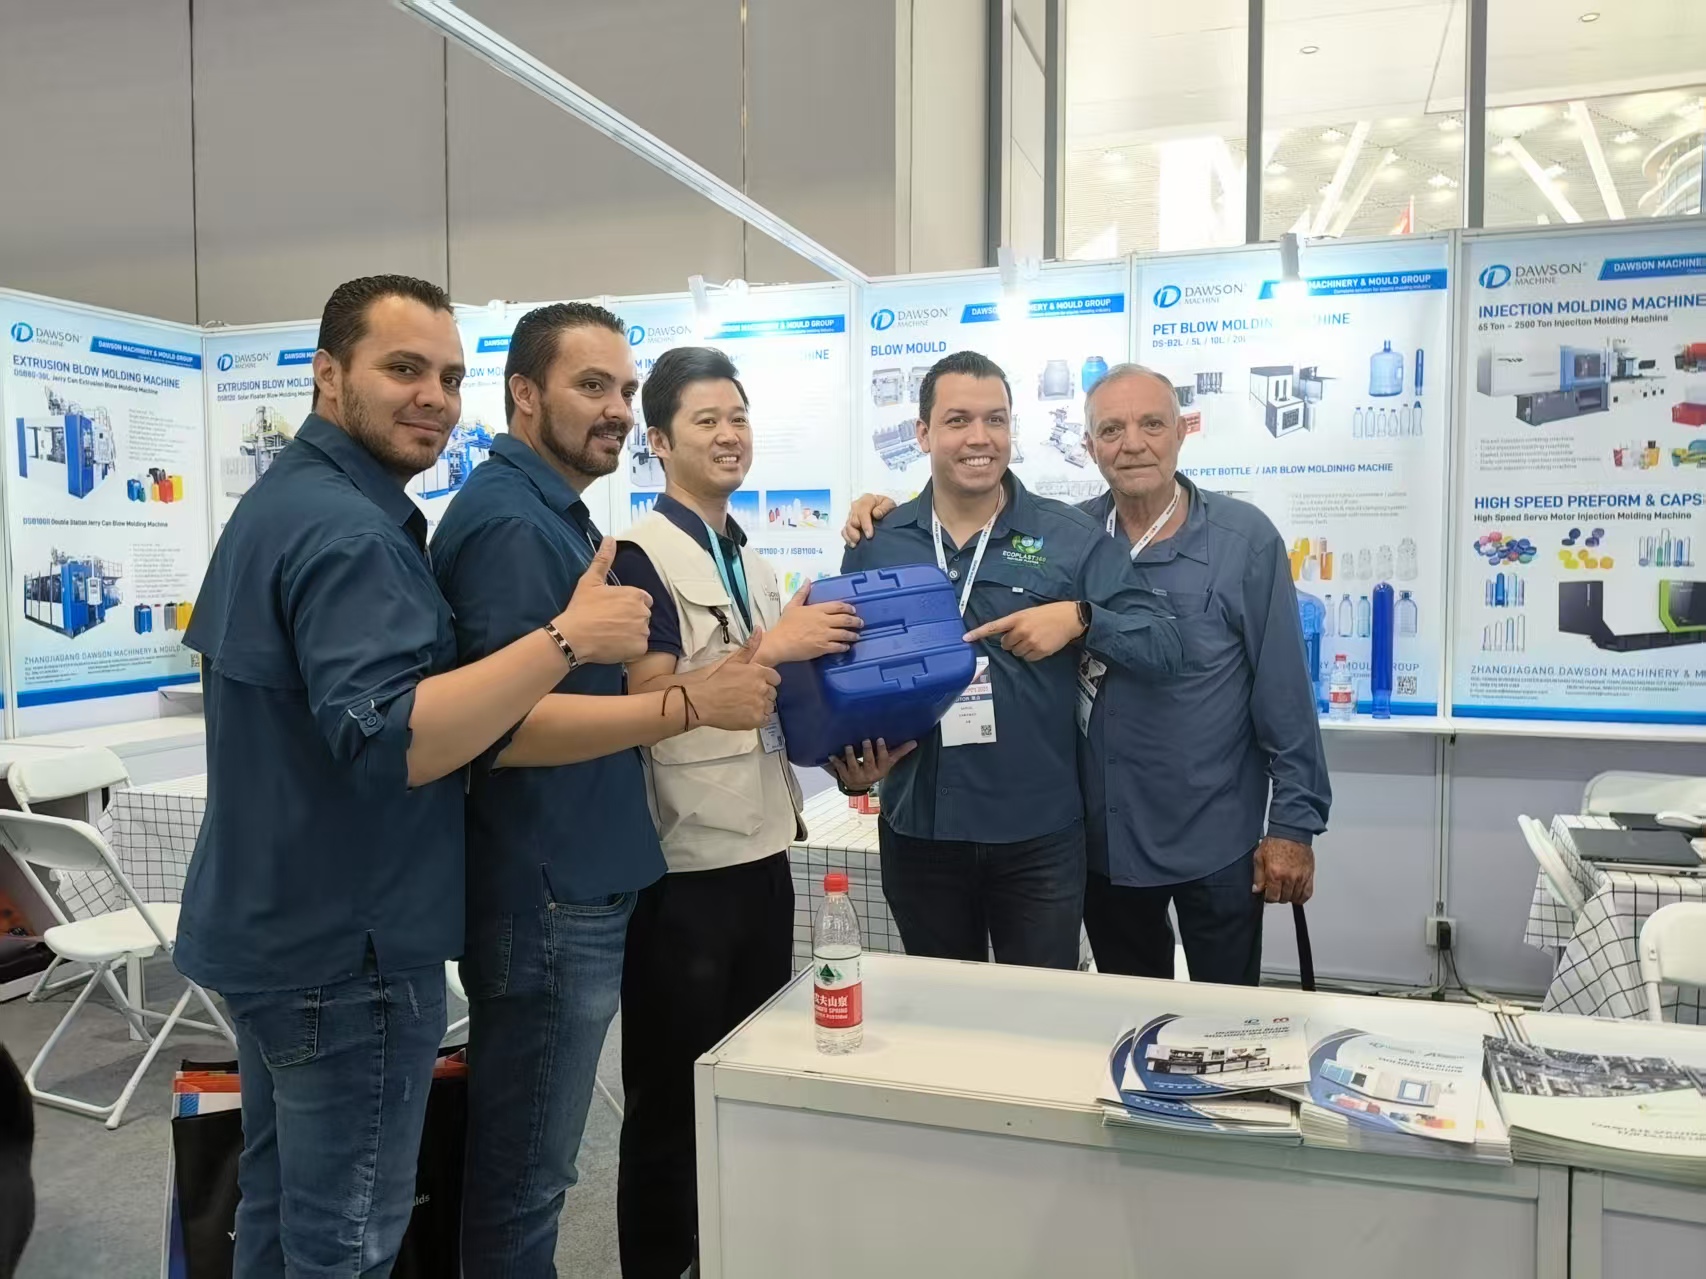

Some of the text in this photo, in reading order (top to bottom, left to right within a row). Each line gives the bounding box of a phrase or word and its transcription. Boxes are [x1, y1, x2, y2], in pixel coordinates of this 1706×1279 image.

[1515, 262, 1582, 278] DAWSON
[1614, 260, 1655, 273] DAWSON
[1308, 279, 1358, 289] MACHINERY
[1368, 277, 1399, 286] MOULD
[1401, 274, 1431, 283] GROUP
[1515, 277, 1556, 287] MACHINE
[1185, 283, 1243, 298] DAWSON
[1056, 300, 1083, 310] MOULD
[1084, 298, 1111, 307] GROUP
[1479, 293, 1706, 319] INJECTION MOLDING MACHINE
[898, 308, 948, 321] DAWSON
[971, 307, 998, 316] DAWSO
[786, 320, 810, 329] MOULD
[811, 319, 835, 327] GROUP
[897, 320, 929, 328] MACHINE
[1153, 312, 1351, 335] PET BLOW MOLDIN HINE
[1478, 323, 1488, 331] 65
[1490, 321, 1505, 331] Ton
[1514, 320, 1536, 329] 2500
[1537, 319, 1553, 328] Ton
[1594, 315, 1629, 326] Molding
[1631, 313, 1669, 324] Machine
[36, 328, 80, 343] DAWSON
[647, 326, 692, 337] DAWSON
[98, 340, 122, 350] DAWSON
[1191, 338, 1201, 346] 5L
[871, 341, 947, 357] BLOW MOULD
[234, 352, 269, 363] DAWSON
[284, 352, 305, 360] DAWSON
[13, 354, 180, 389] EXTRUSION BLOW MOLDING MACHINE
[465, 367, 485, 378] LOW
[217, 377, 315, 392] EXTRUSION BLOW MOLDI
[1200, 468, 1216, 476] PET
[1218, 466, 1251, 475] BOTTLE
[1280, 465, 1306, 475] BLOW
[1308, 464, 1356, 473] MOLDINHG
[1358, 463, 1393, 472] MACHIE
[1474, 493, 1703, 509] HIGH SPEED PREFORM & CAPS
[1473, 510, 1692, 522] High Speed Servo Motor Injection Molding Machine
[81, 649, 112, 660] DAWSON
[113, 647, 152, 657] MACHINERY
[1342, 661, 1420, 672] MOUL ROUP
[1471, 664, 1555, 675] ZHANGJIAGANG
[1559, 666, 1608, 677] DAWSON
[1611, 667, 1680, 679] MACHINERY
